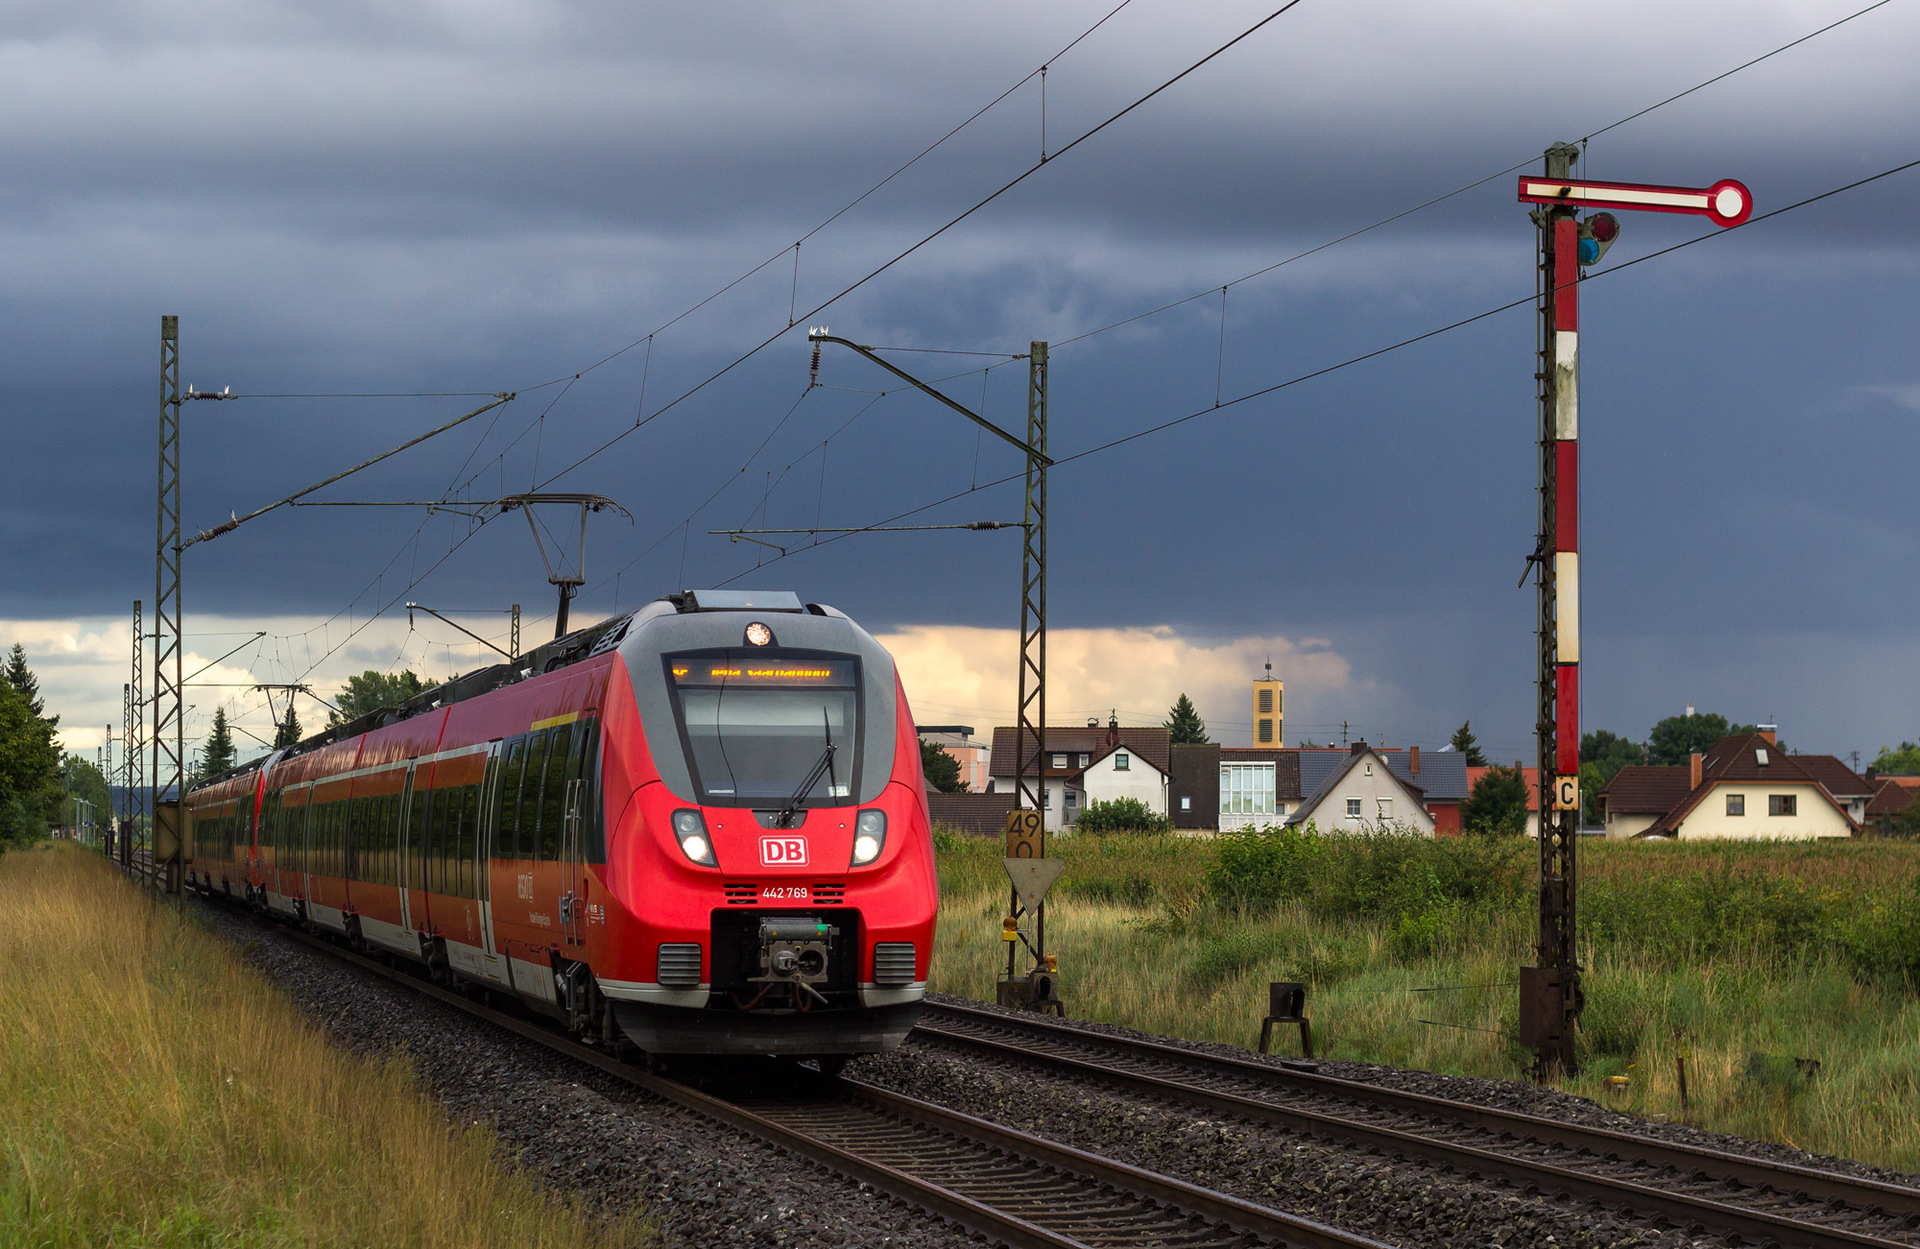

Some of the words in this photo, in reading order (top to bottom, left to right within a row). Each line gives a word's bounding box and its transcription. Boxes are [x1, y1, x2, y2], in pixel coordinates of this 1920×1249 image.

[1561, 782, 1573, 805] C
[1008, 814, 1040, 837] 49
[764, 840, 804, 862] DB
[762, 887, 784, 899] 442
[786, 887, 808, 899] 769
